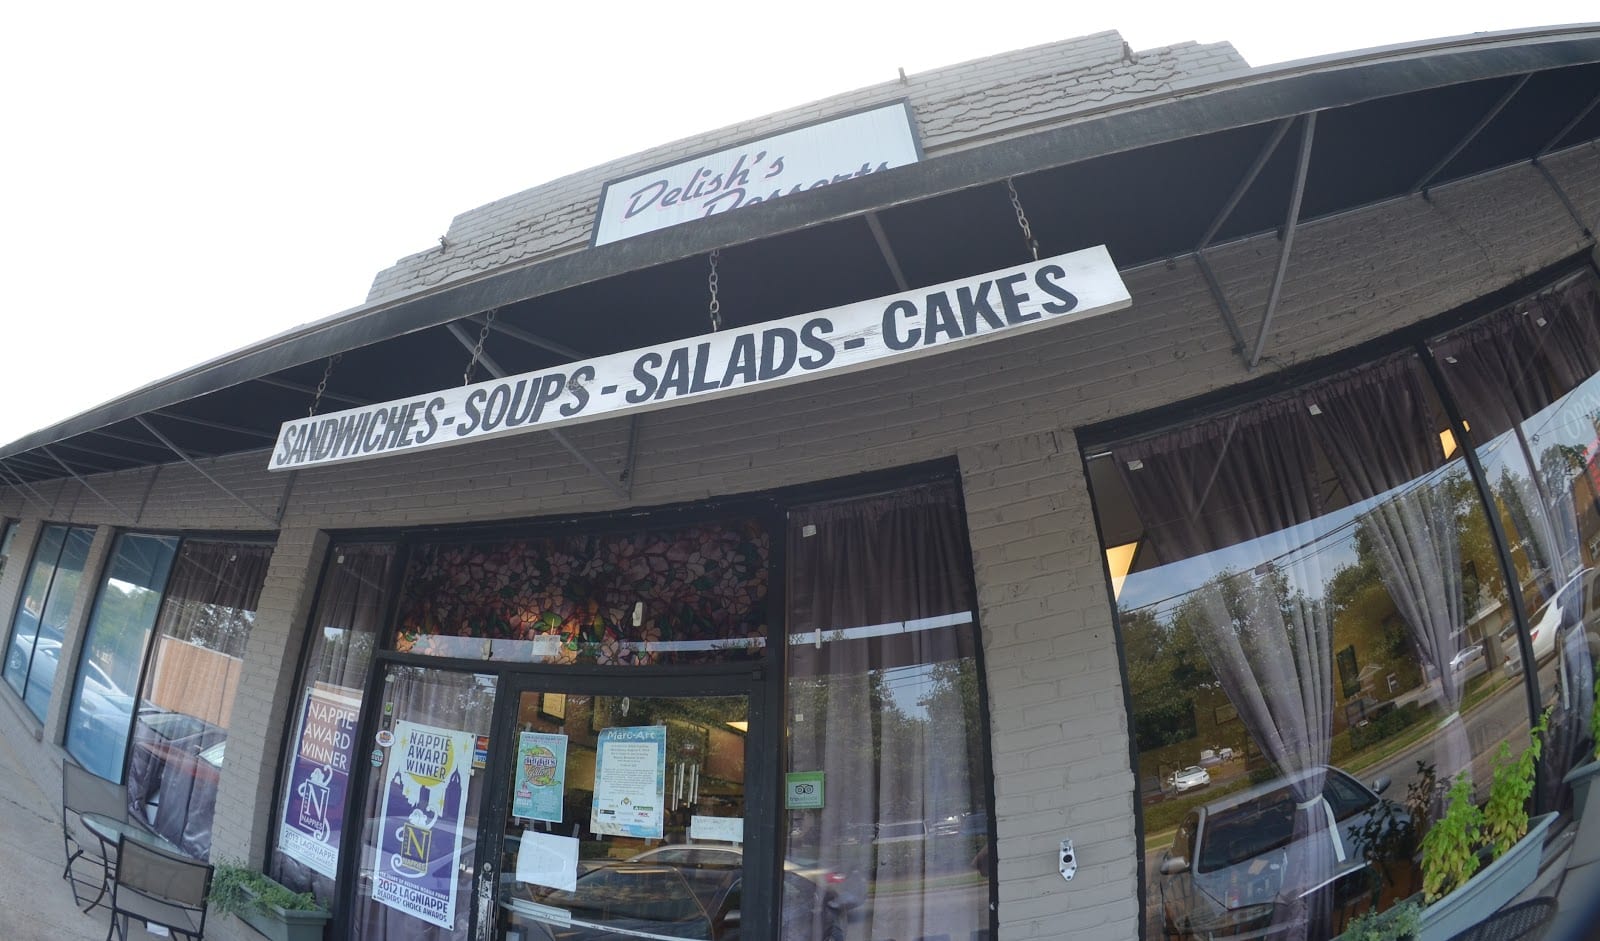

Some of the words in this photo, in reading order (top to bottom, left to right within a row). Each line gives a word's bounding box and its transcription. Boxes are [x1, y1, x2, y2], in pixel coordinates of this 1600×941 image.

[621, 150, 784, 220] Delish's
[276, 396, 445, 466] SANDWICHES
[456, 365, 596, 437] SOUPS
[625, 317, 836, 404] SALADS
[881, 264, 1079, 352] CAKES
[308, 700, 355, 731] NAPPIE
[304, 722, 351, 750] AWARD
[409, 731, 452, 752] NAPPIE
[302, 740, 347, 770] WINNER
[406, 759, 446, 780] WINNER
[407, 745, 448, 766] AWARD
[379, 879, 398, 895] 2012
[399, 887, 449, 914] LAGNIAPPE
[402, 899, 422, 913] CHOICE
[423, 908, 448, 923] AWARDS
